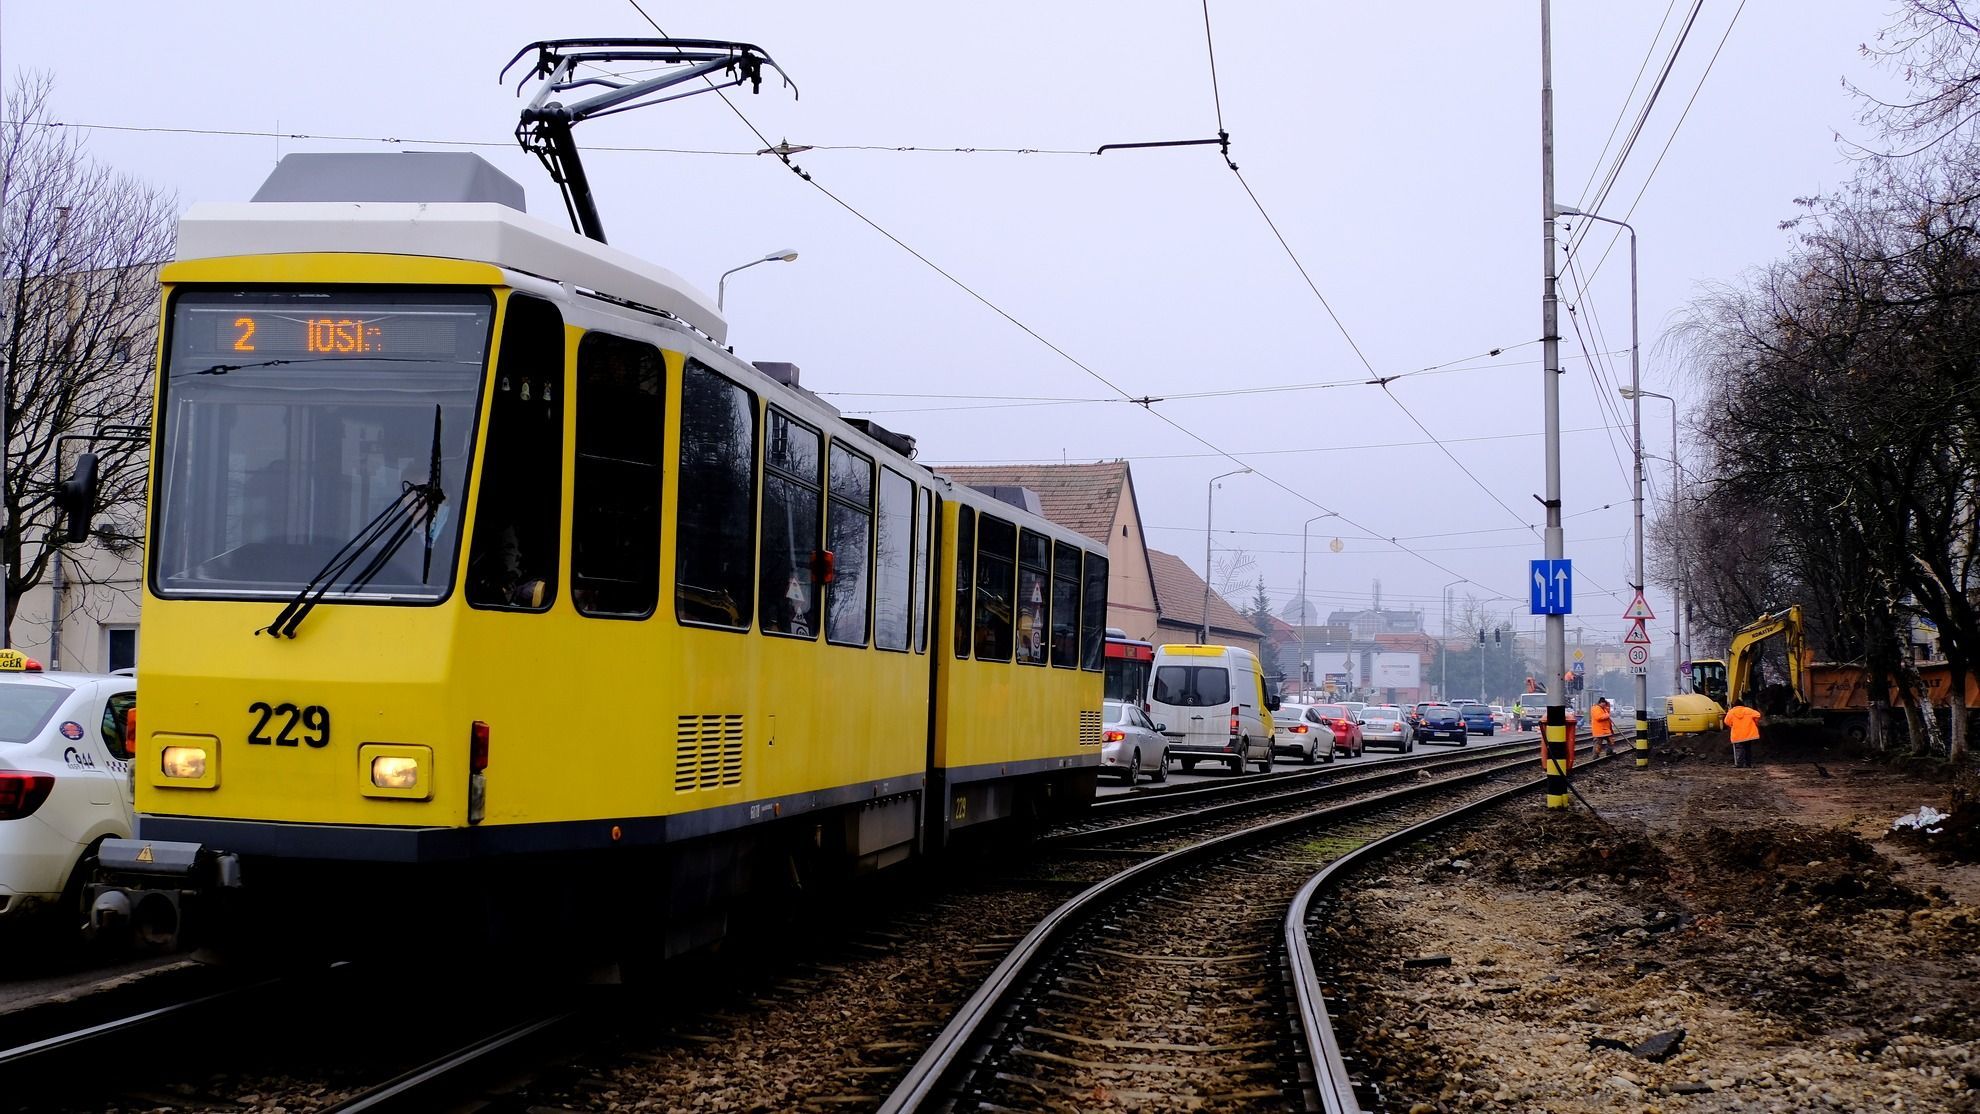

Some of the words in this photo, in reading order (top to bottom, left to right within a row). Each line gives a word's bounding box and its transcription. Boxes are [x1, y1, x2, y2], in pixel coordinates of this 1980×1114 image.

[233, 317, 256, 351] 2
[307, 319, 382, 353] IOSI
[0, 658, 22, 668] GER
[1633, 650, 1644, 660] 30
[1630, 666, 1648, 674] ZONA
[247, 701, 331, 749] 229
[75, 752, 96, 769] 944
[955, 796, 967, 820] 229
